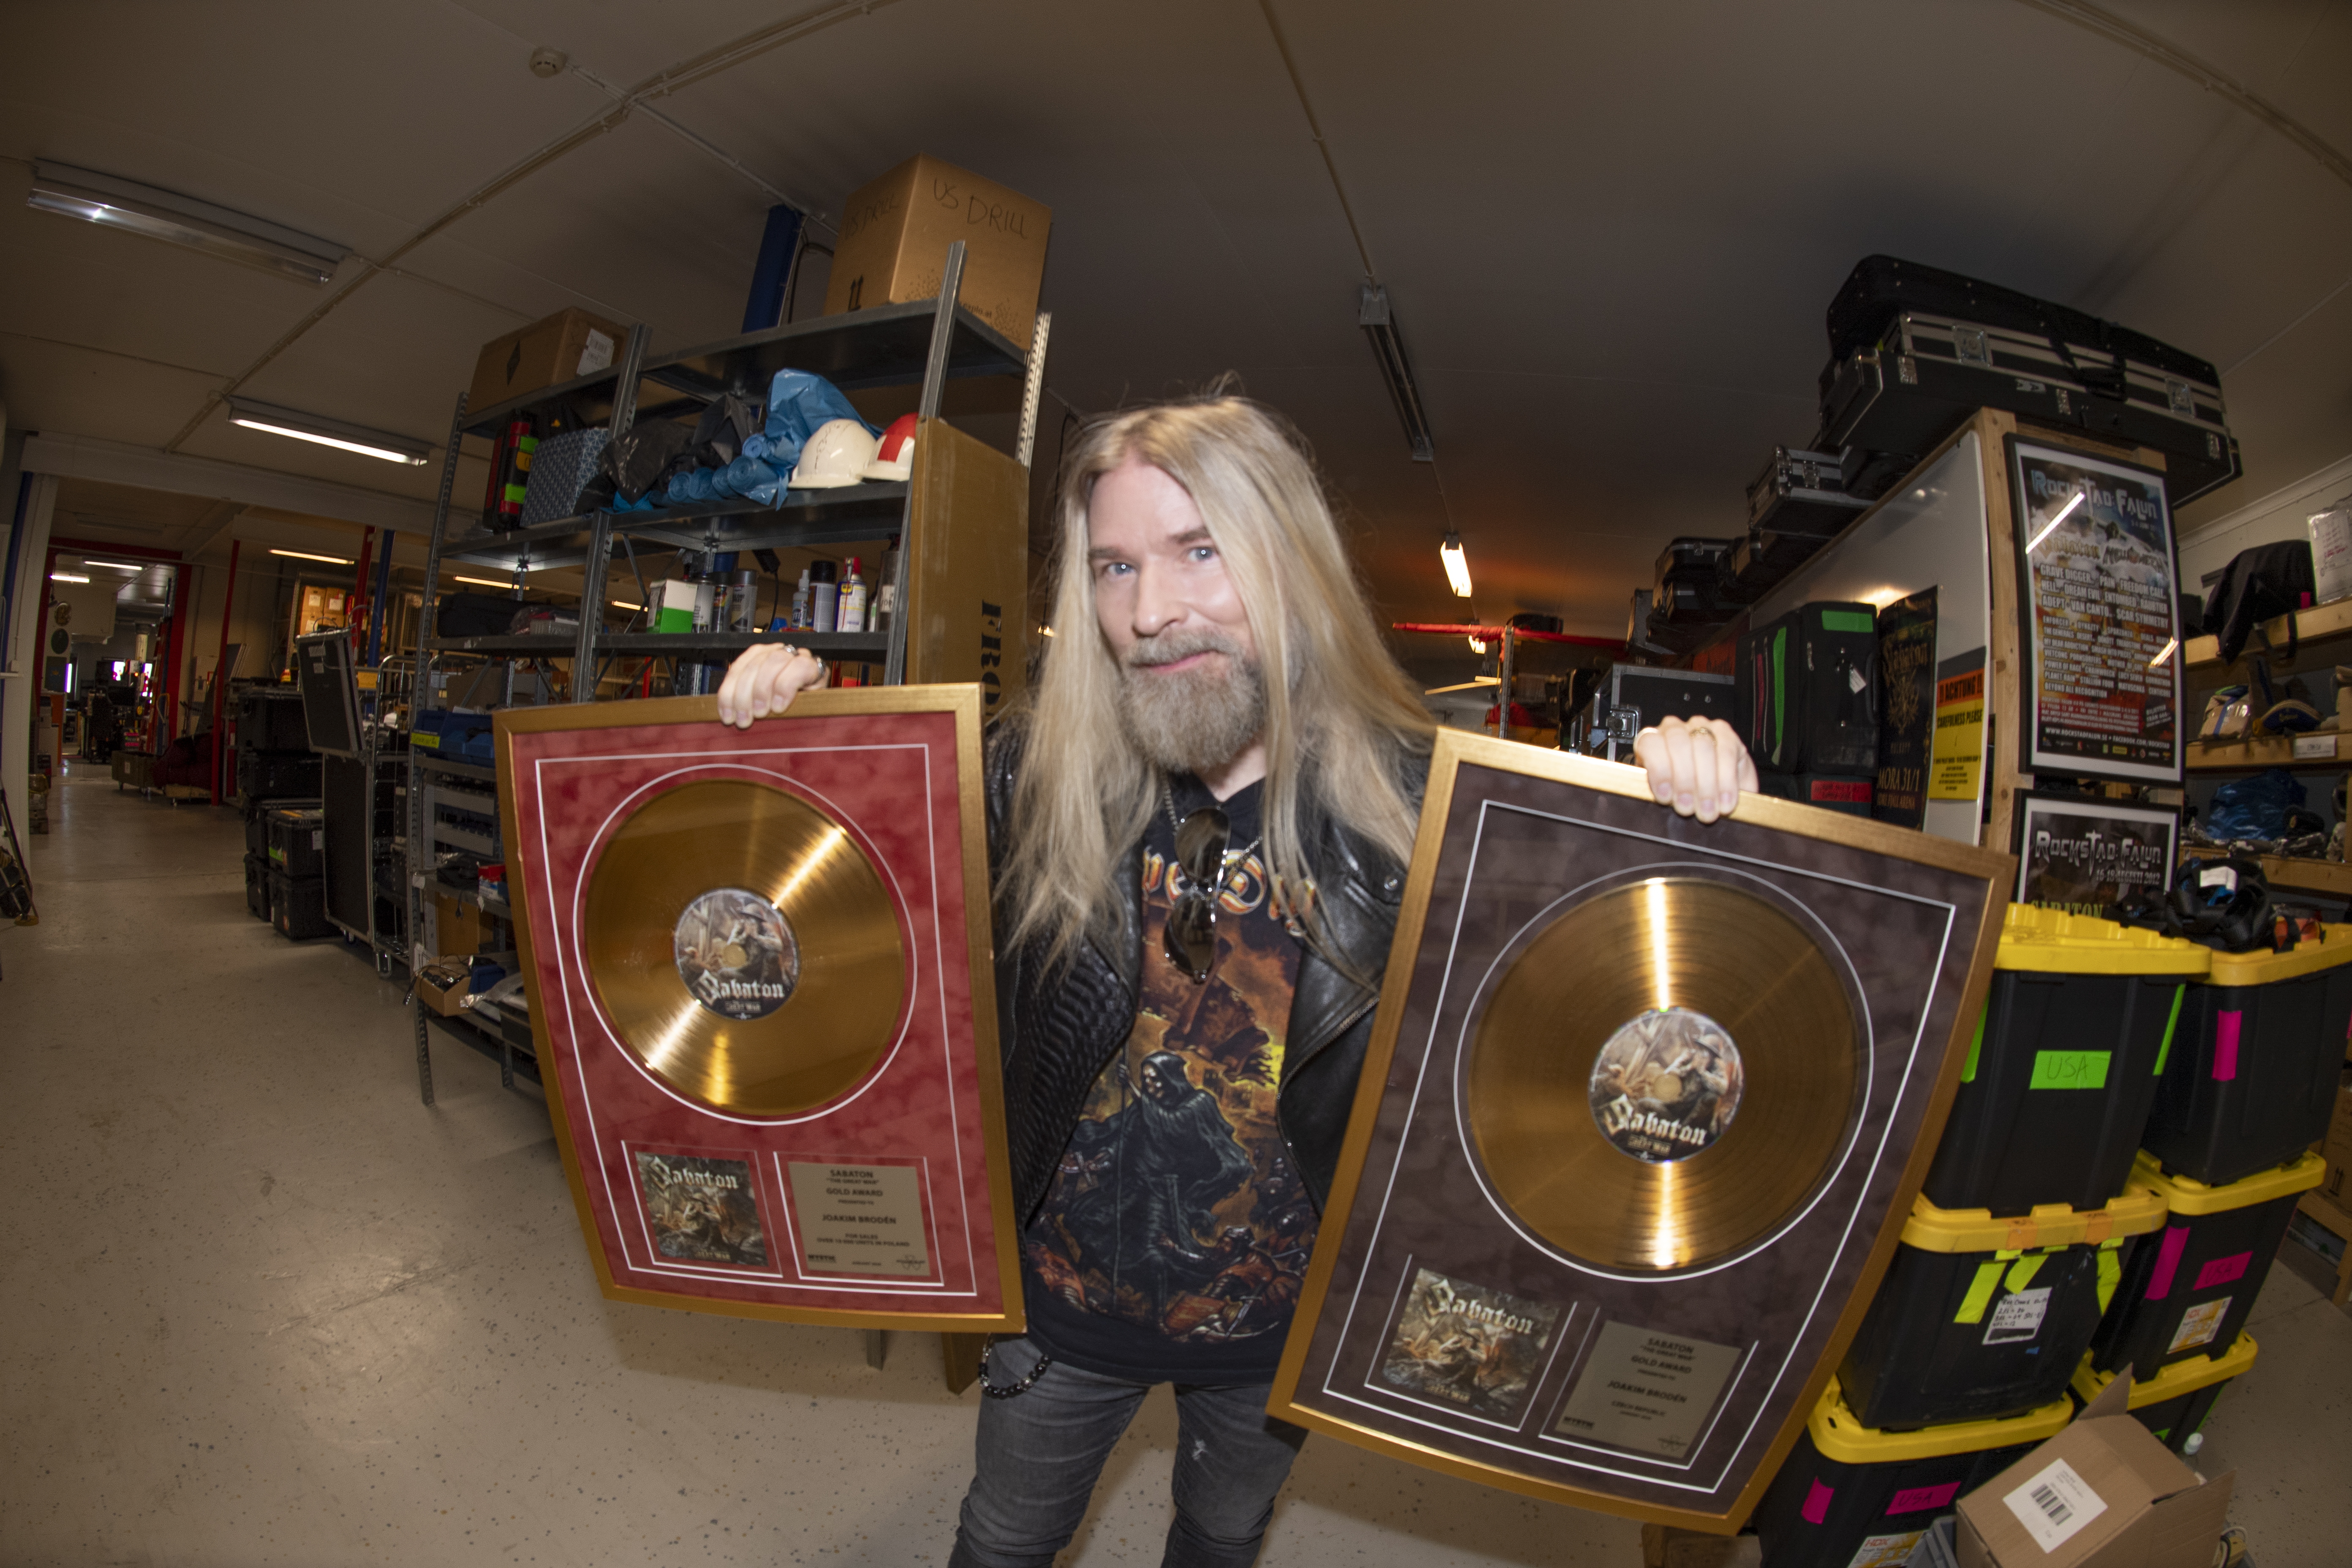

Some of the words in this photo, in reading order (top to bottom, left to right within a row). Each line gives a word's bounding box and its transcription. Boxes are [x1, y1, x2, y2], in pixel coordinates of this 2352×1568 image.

[933, 178, 959, 209] US
[967, 196, 1027, 239] DRILL
[2040, 564, 2064, 578] GRAVE
[2065, 569, 2091, 583] DIGGER
[2100, 576, 2115, 588] PAIN
[2121, 579, 2149, 594] FREEDOM
[2064, 583, 2087, 597] DREAM
[2088, 588, 2101, 600] EVIL
[2105, 591, 2137, 607] ENTOMBED
[2043, 596, 2065, 609] ADEPT
[2071, 600, 2085, 612] VAN
[2087, 603, 2109, 617] CANTO
[2117, 609, 2134, 621] SCAR
[2136, 612, 2168, 628] SYMMETRY
[2043, 615, 2069, 627] ENFORCER
[1946, 677, 1976, 700] ACHTUNG
[1937, 712, 1965, 728] CAREFULNESS
[1966, 709, 1982, 725] PLEASE
[1877, 767, 1900, 790] MORA
[1901, 767, 1920, 792] 31/1
[2144, 872, 2161, 885] 2012
[695, 970, 785, 1007] Sabaton
[2047, 1054, 2088, 1081] USA
[1603, 1094, 1707, 1146] Sabaton
[650, 1156, 739, 1191] Sabaton
[830, 1170, 873, 1178] SABATON
[858, 1216, 896, 1224] BRODÉN
[1424, 1278, 1535, 1334] Sabaton
[1648, 1338, 1694, 1353] SABATON
[1631, 1355, 1657, 1367] GOLD
[1658, 1361, 1692, 1374] AWARD
[1608, 1380, 1645, 1394] JOAKIM
[1647, 1388, 1687, 1403] BRODÉN
[1898, 1492, 1933, 1507] USA
[1865, 1538, 1890, 1546] HDX
